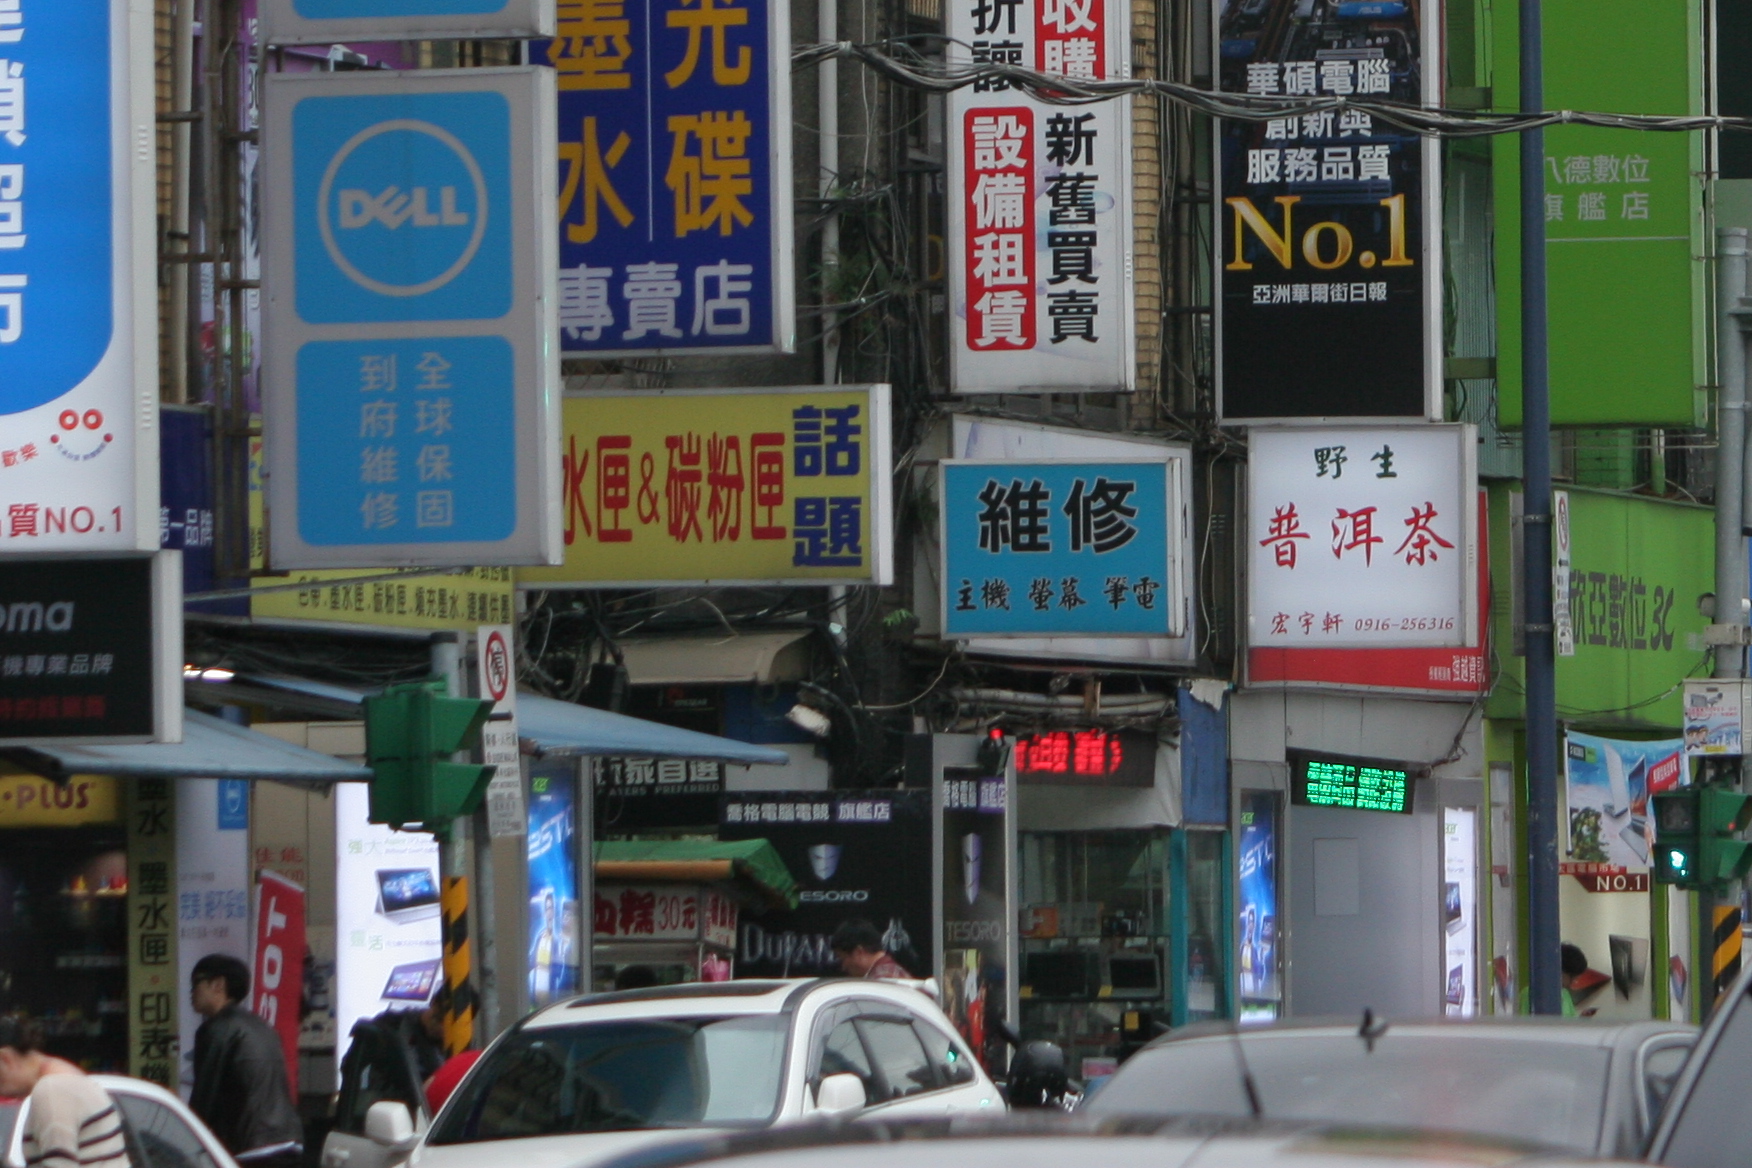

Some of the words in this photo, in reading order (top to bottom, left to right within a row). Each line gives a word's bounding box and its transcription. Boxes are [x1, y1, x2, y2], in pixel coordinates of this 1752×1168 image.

[1246, 58, 1391, 97] 華碩電腦
[1247, 144, 1392, 185] 服務品質
[339, 185, 470, 230] DELL
[972, 114, 1028, 350] 設備租賃
[1044, 112, 1100, 346] 新舊買賣
[1226, 193, 1414, 271] No.1
[559, 258, 754, 342] 專賣店
[1252, 281, 1388, 304] 亞洲華爾街日報
[359, 354, 400, 531] 到府維修
[416, 351, 453, 528] 全球保固
[1314, 444, 1397, 480] 野生
[563, 431, 787, 547] 水匣&碳粉匣
[792, 403, 863, 568] 話題
[0, 503, 124, 538] 質NO.1
[978, 478, 1139, 554] 維修
[1259, 501, 1455, 570] 普洱茶
[955, 579, 1011, 612] 主機
[1028, 578, 1087, 612] 螢幕
[1103, 577, 1161, 610] 筆電
[1271, 610, 1345, 636] 宏宇軒
[1354, 616, 1455, 632] 0916-256316
[1567, 568, 1675, 653] 欣亞數位3C
[597, 785, 647, 797] AYERS
[655, 784, 720, 796] PREFERRED
[725, 803, 830, 823] 喬格電腦電競
[838, 801, 892, 821] 旗艦店
[1596, 874, 1643, 892] NO.1
